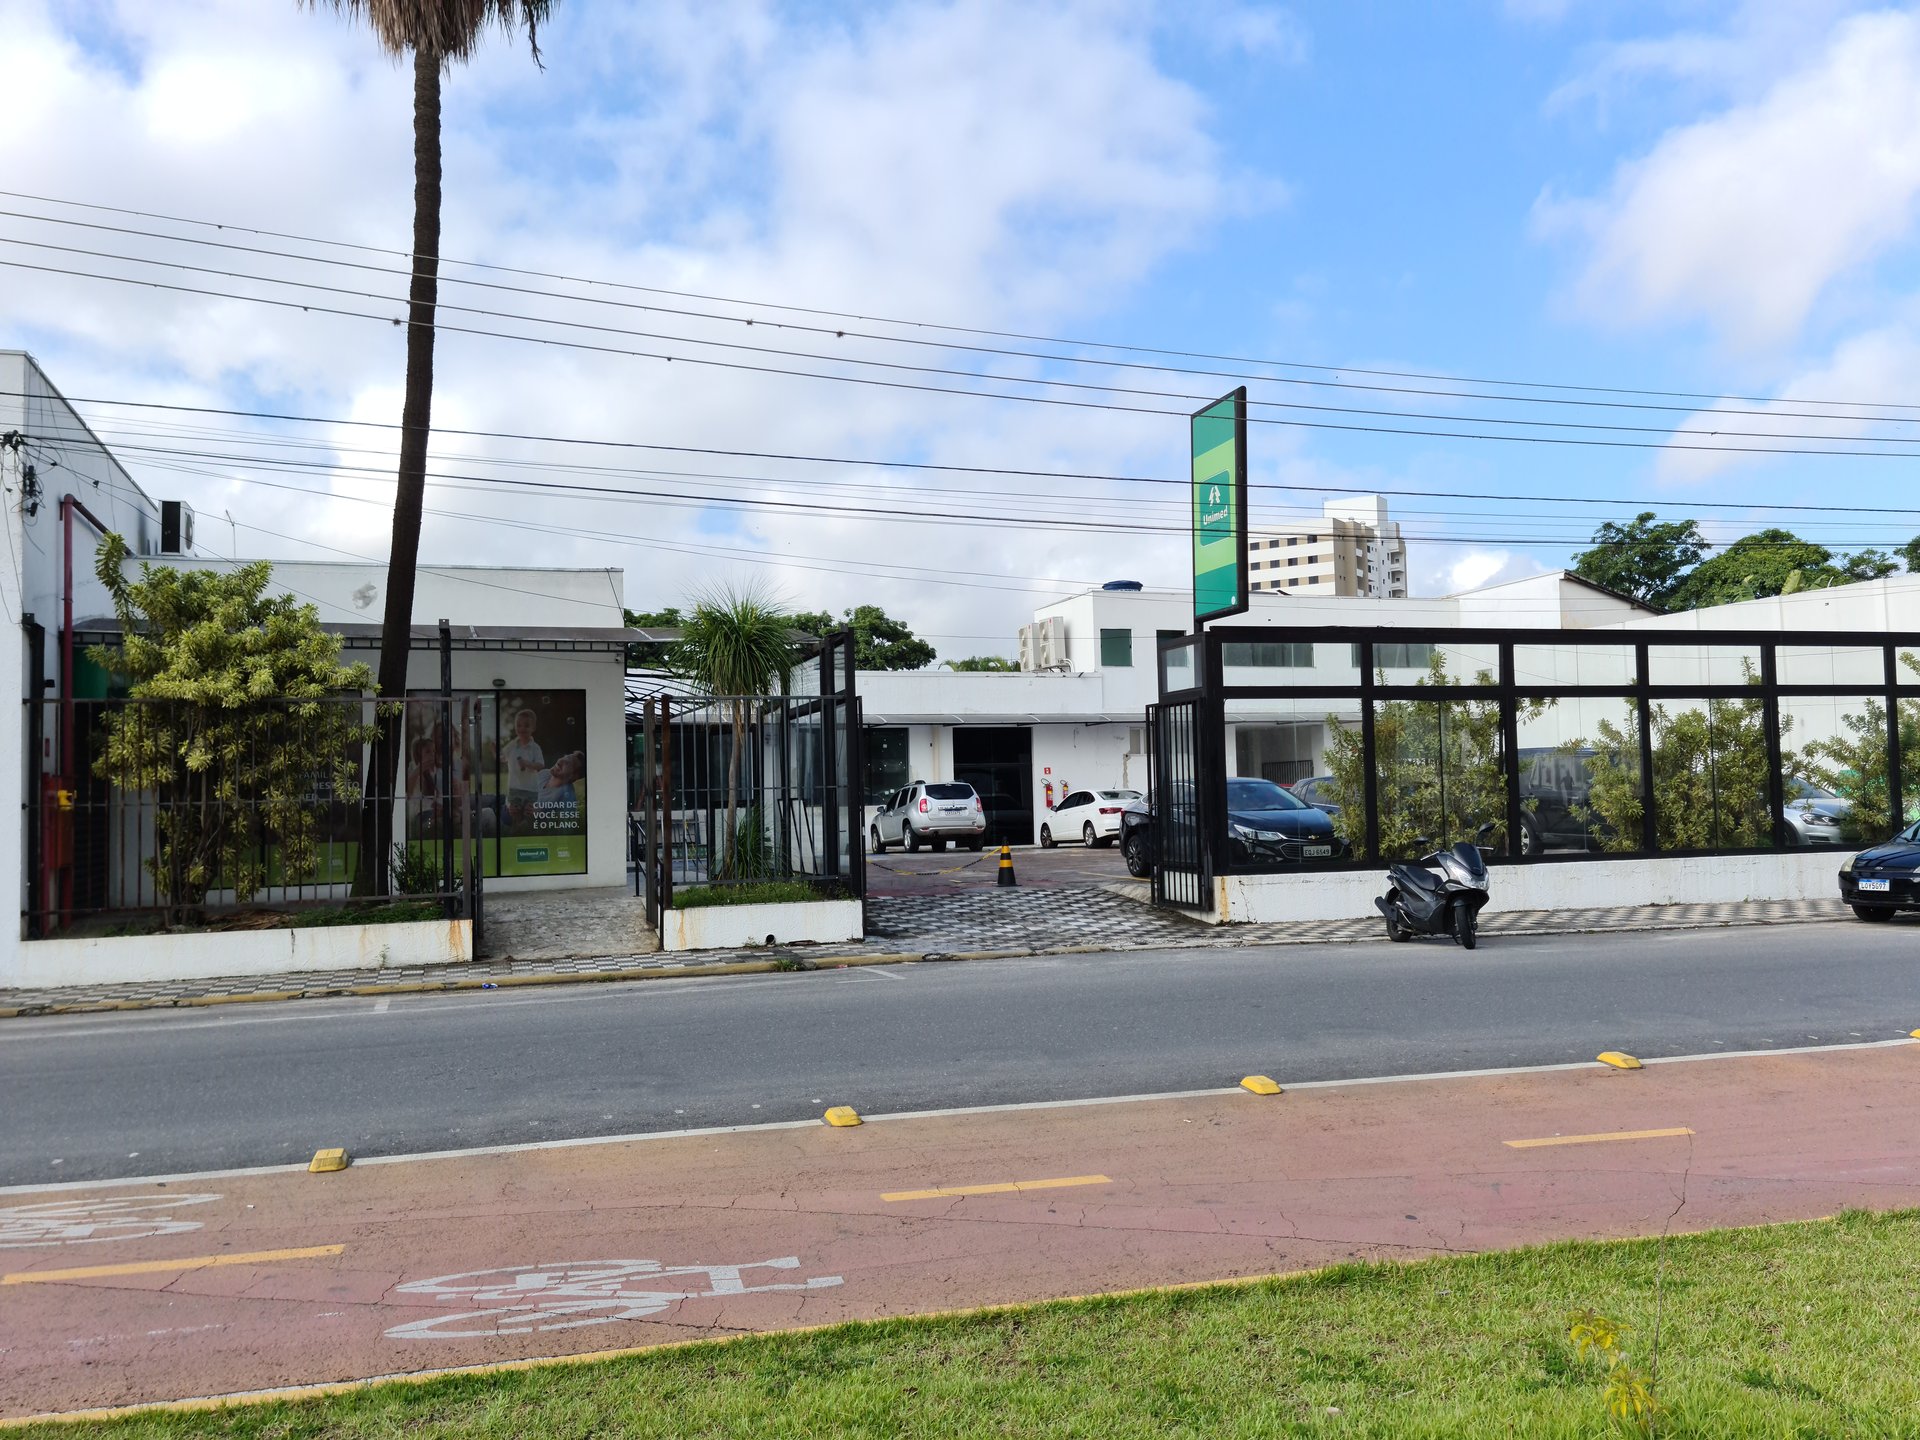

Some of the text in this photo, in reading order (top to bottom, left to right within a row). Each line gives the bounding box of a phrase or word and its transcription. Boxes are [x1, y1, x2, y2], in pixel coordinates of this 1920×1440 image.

[1203, 505, 1228, 525] Unimed
[533, 801, 577, 809] CUIDAR DE
[533, 810, 580, 819] VOCÊ. ESSE
[533, 820, 580, 829] É O PLANO.
